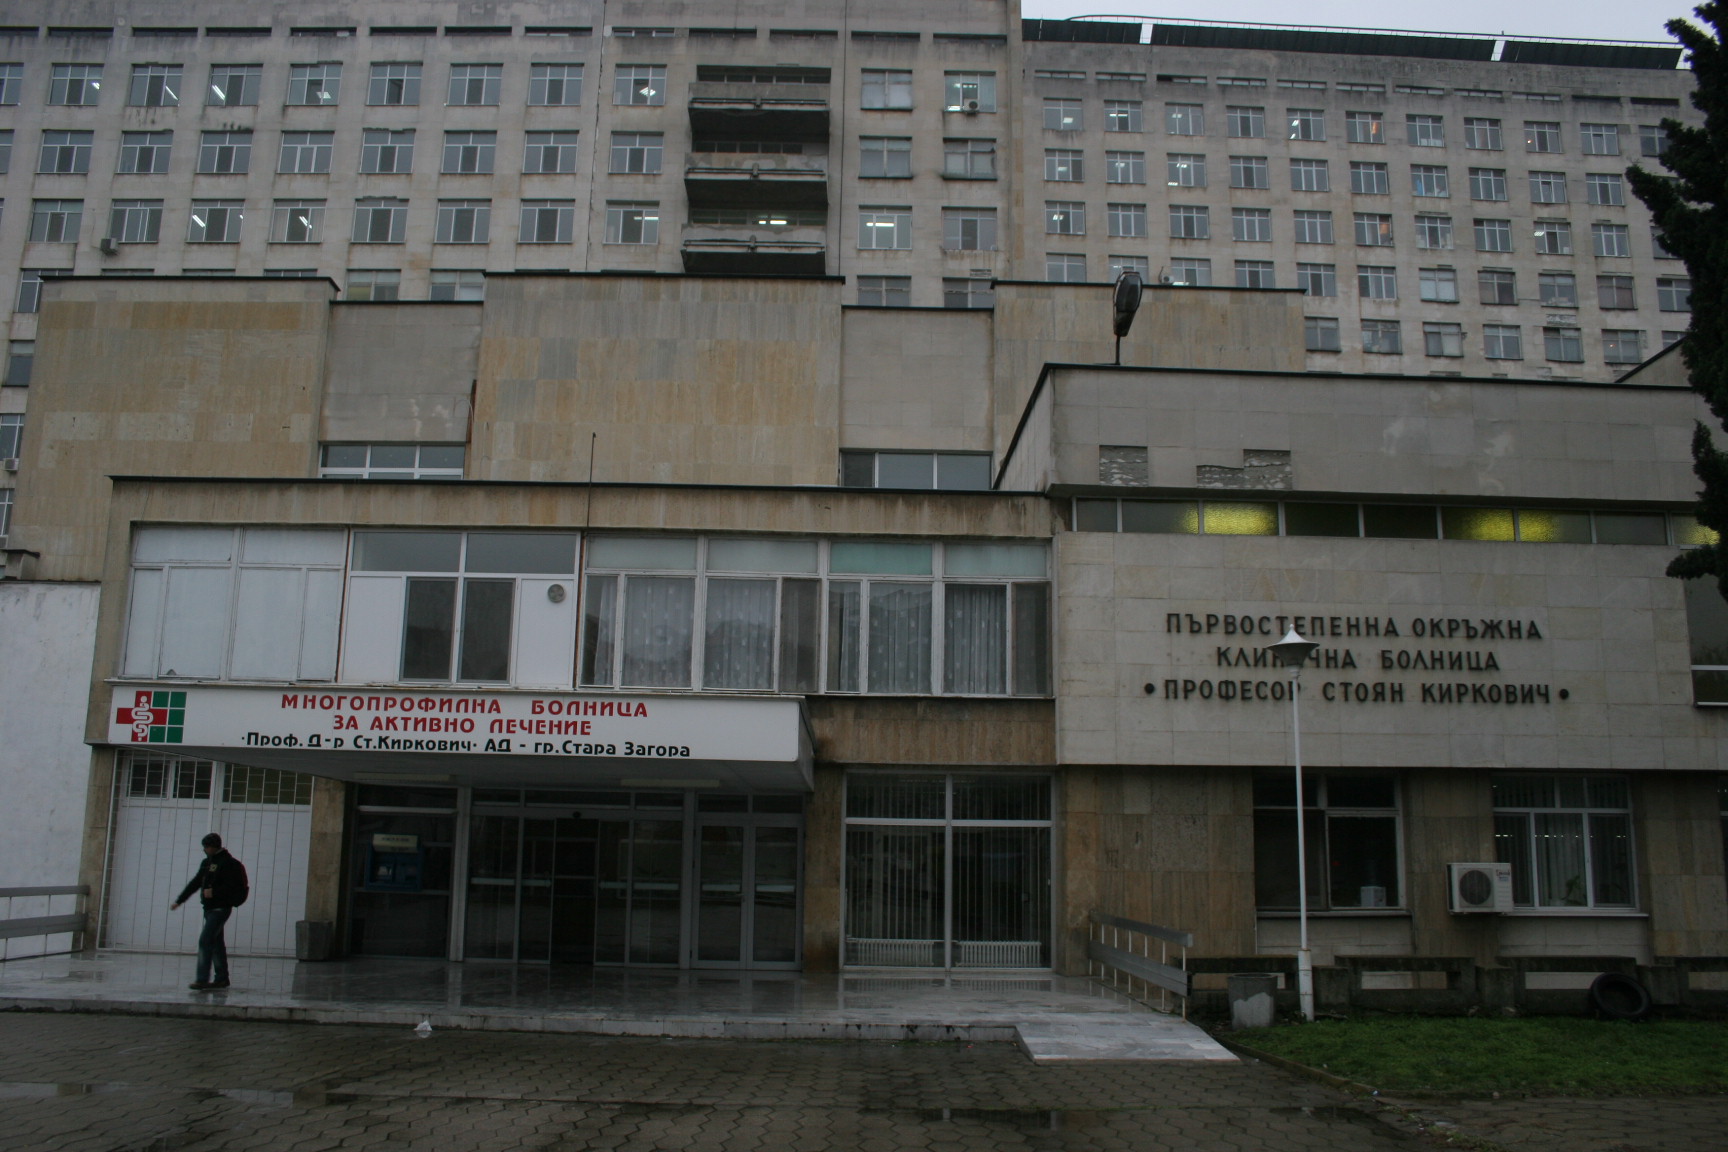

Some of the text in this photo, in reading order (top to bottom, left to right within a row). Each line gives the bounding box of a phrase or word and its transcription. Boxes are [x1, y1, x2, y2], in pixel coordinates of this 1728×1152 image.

[1166, 613, 1543, 641] ПЪРВОСТЕПЕННА ОКРЪЖНА
[1216, 646, 1501, 674] КЛИНЧНА БОЛНИЦА
[1322, 681, 1405, 704] СТОЯН
[1420, 682, 1551, 706] КИРКОВИЧ
[282, 695, 649, 718] МНОГОПРОФИЛНА БОЛНИЦА
[335, 714, 592, 736] ЗА АКТИВНО ЛЕЧЕНИЕ
[307, 733, 345, 749] Д-р
[484, 738, 512, 753] АД
[625, 742, 690, 758] Загора
